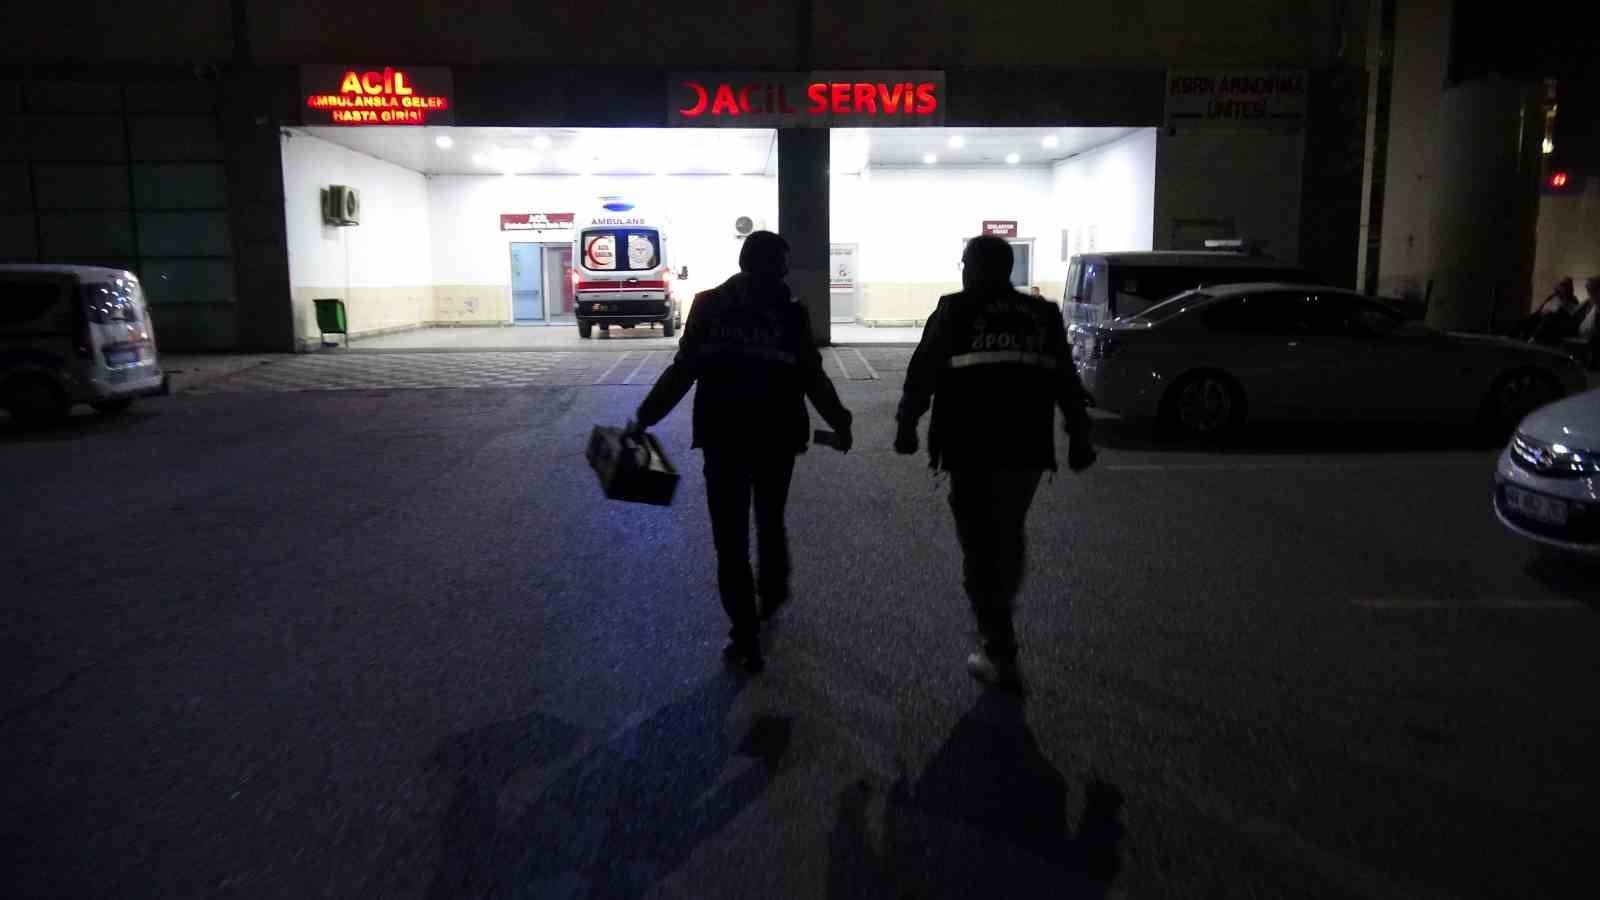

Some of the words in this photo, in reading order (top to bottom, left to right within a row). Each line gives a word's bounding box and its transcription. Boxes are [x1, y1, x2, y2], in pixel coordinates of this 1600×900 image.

[341, 67, 412, 95] ACİL
[807, 82, 937, 115] SERVİS
[332, 110, 379, 121] HASTA
